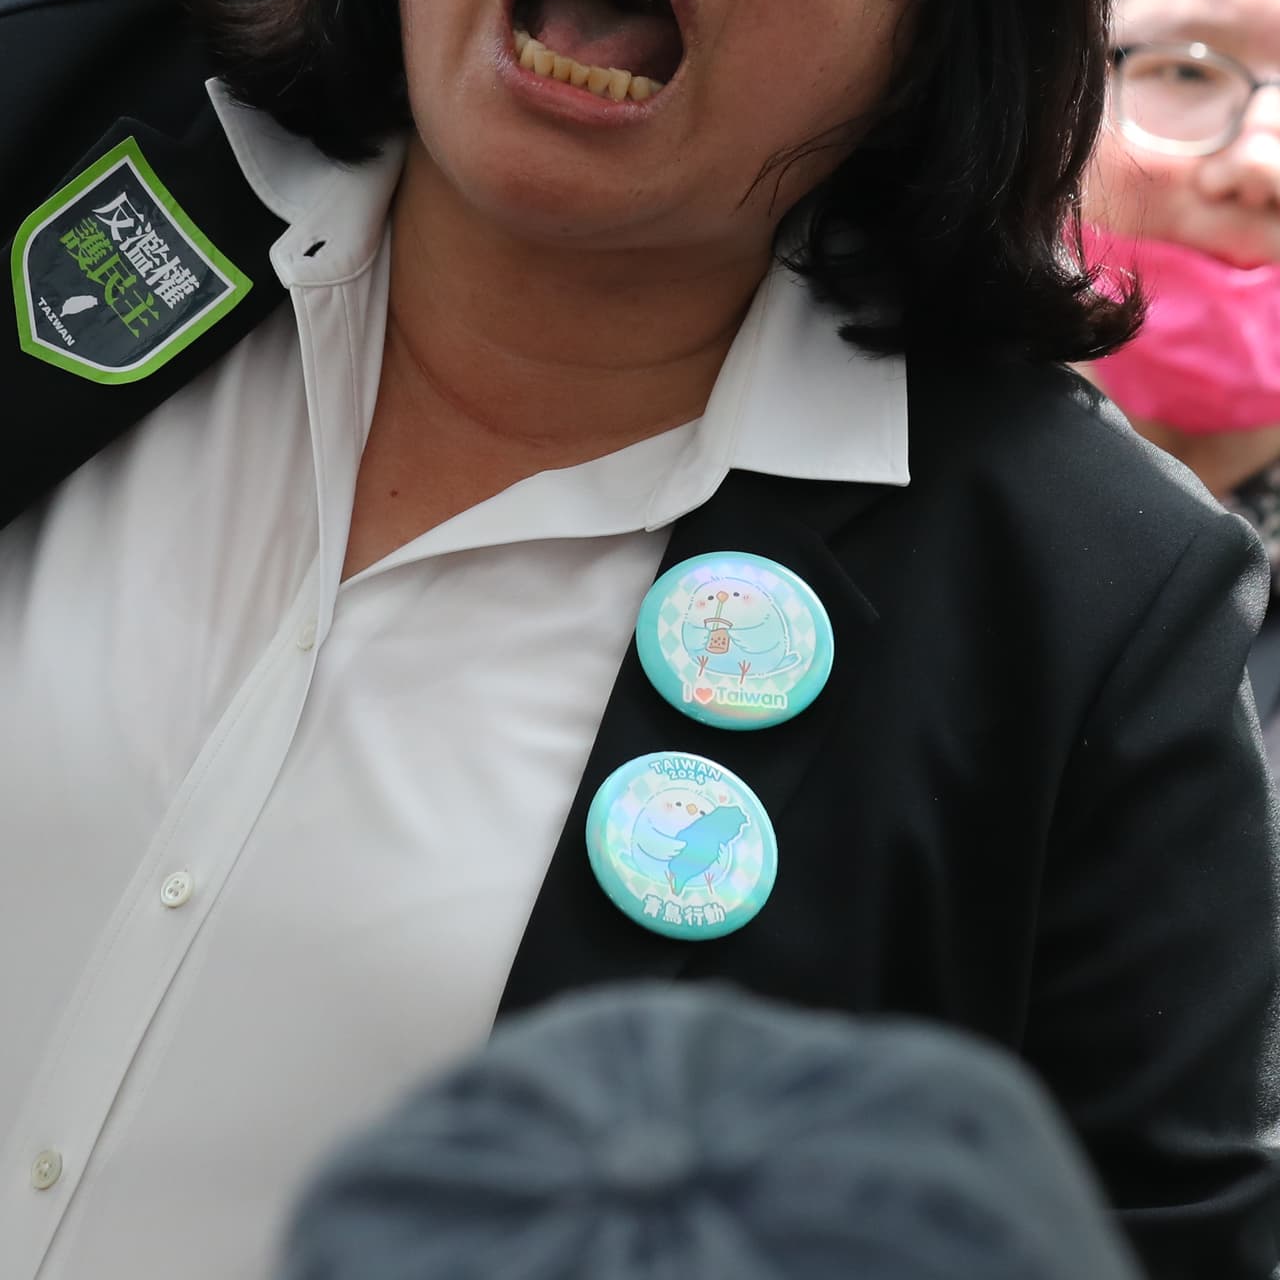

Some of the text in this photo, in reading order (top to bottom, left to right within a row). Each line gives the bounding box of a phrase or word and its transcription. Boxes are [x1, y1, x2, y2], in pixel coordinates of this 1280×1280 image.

[91, 191, 200, 309] 反濫權
[58, 216, 160, 338] 護民主
[36, 296, 76, 348] TAIWAN
[716, 686, 787, 708] Taiwan
[649, 758, 722, 781] TAIWAN
